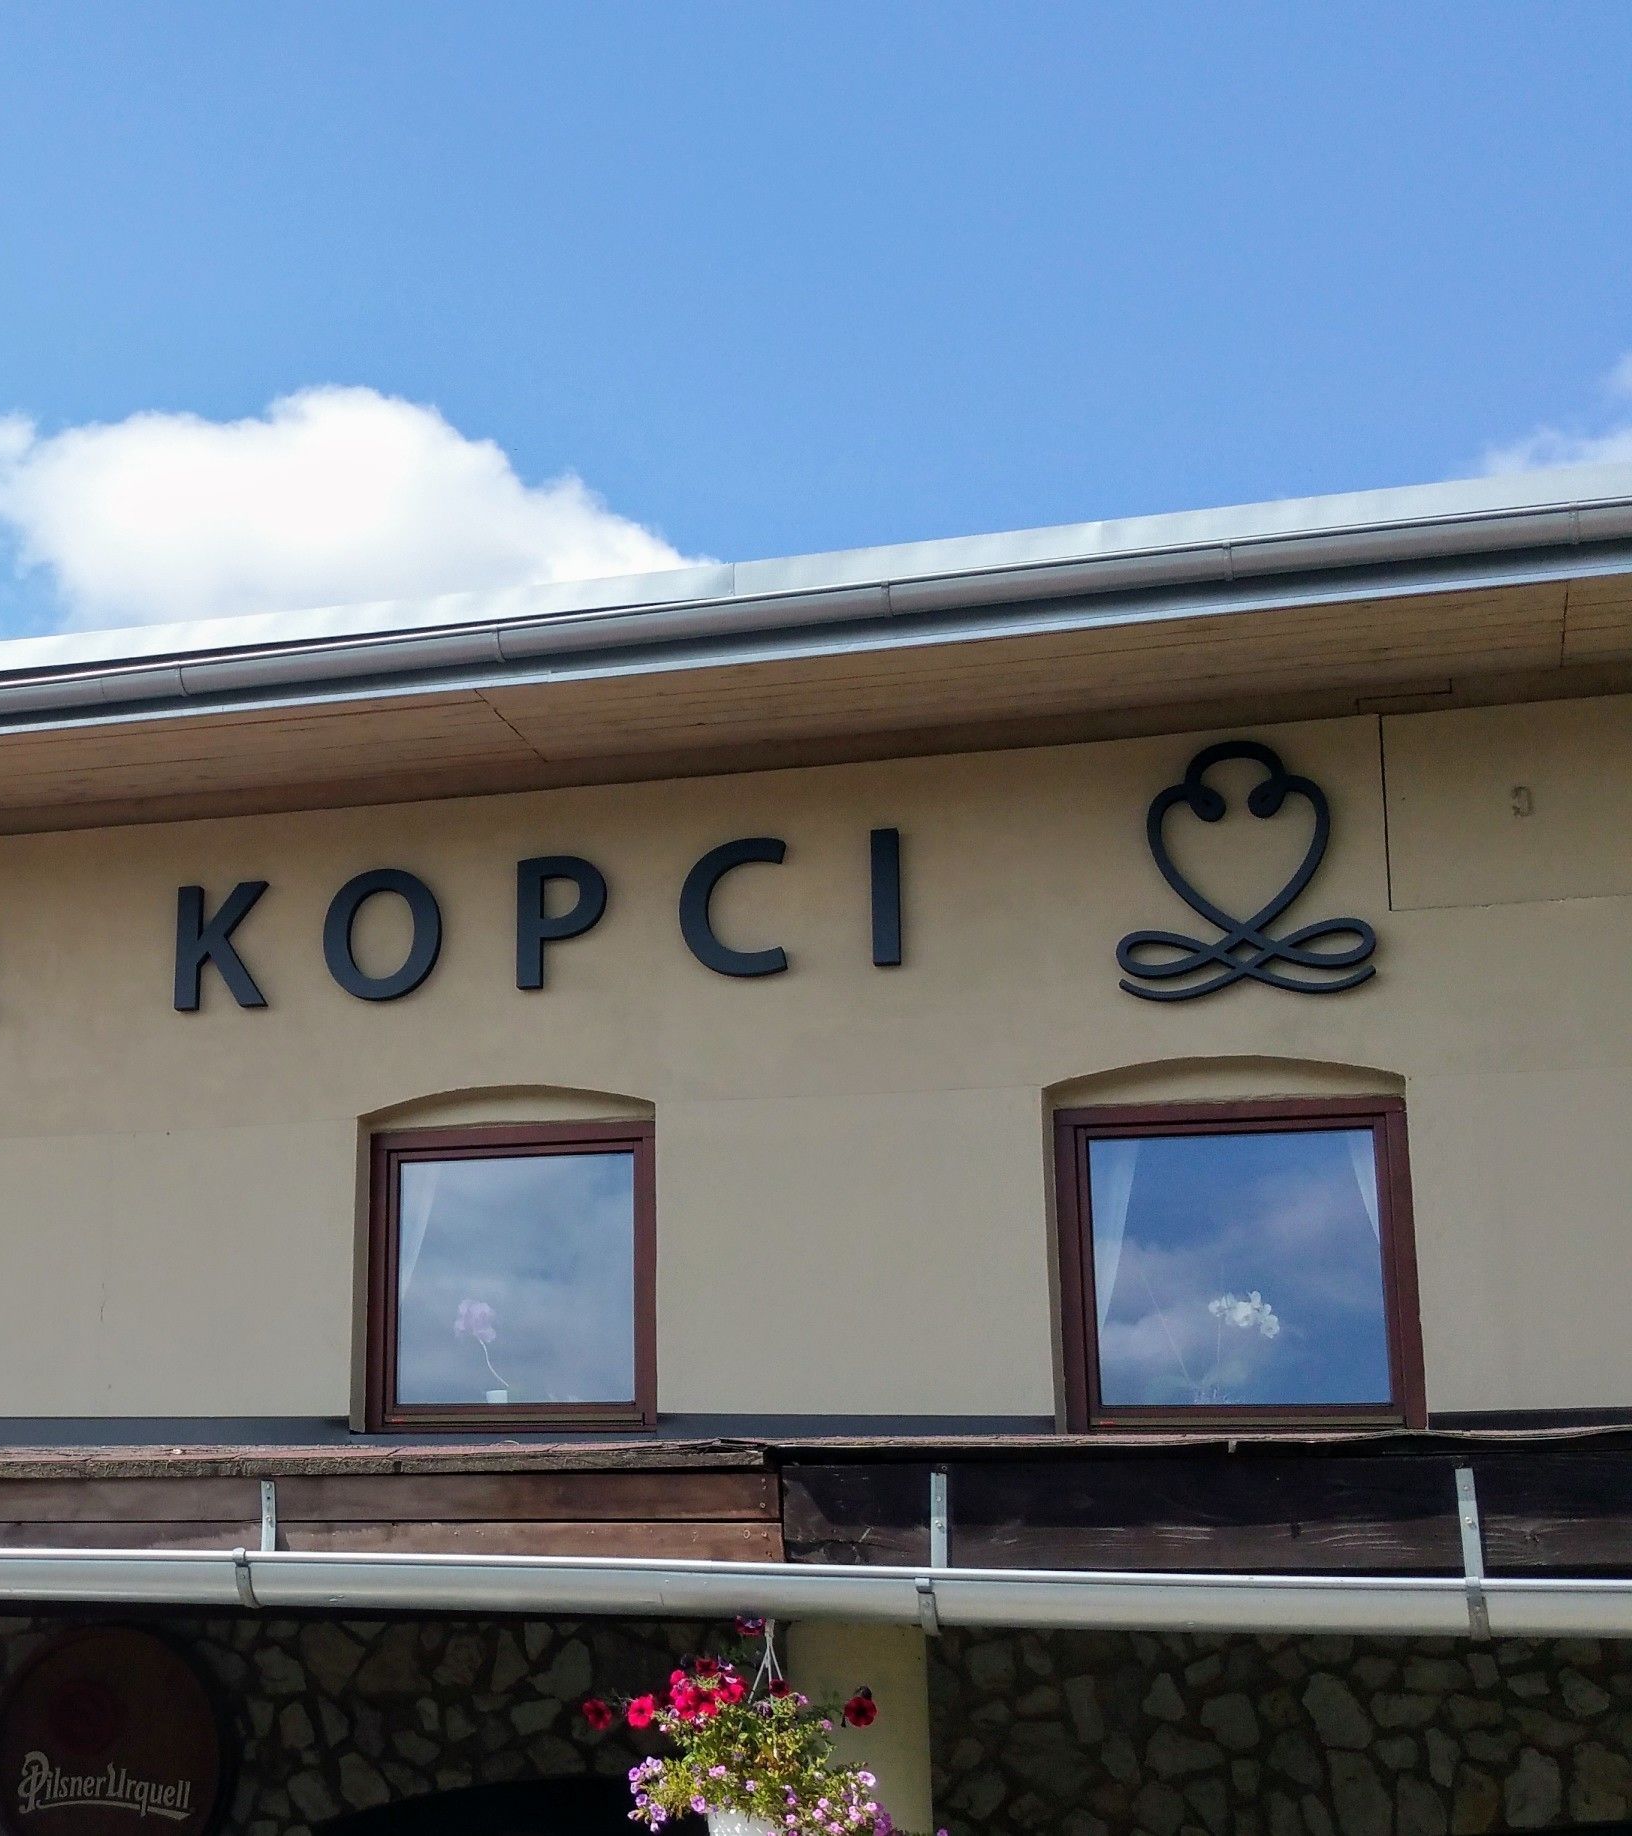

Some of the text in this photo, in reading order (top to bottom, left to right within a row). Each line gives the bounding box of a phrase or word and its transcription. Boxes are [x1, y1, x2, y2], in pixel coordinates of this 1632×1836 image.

[173, 827, 902, 1014] KOPCI
[18, 1750, 191, 1818] Pilsner Urquell
